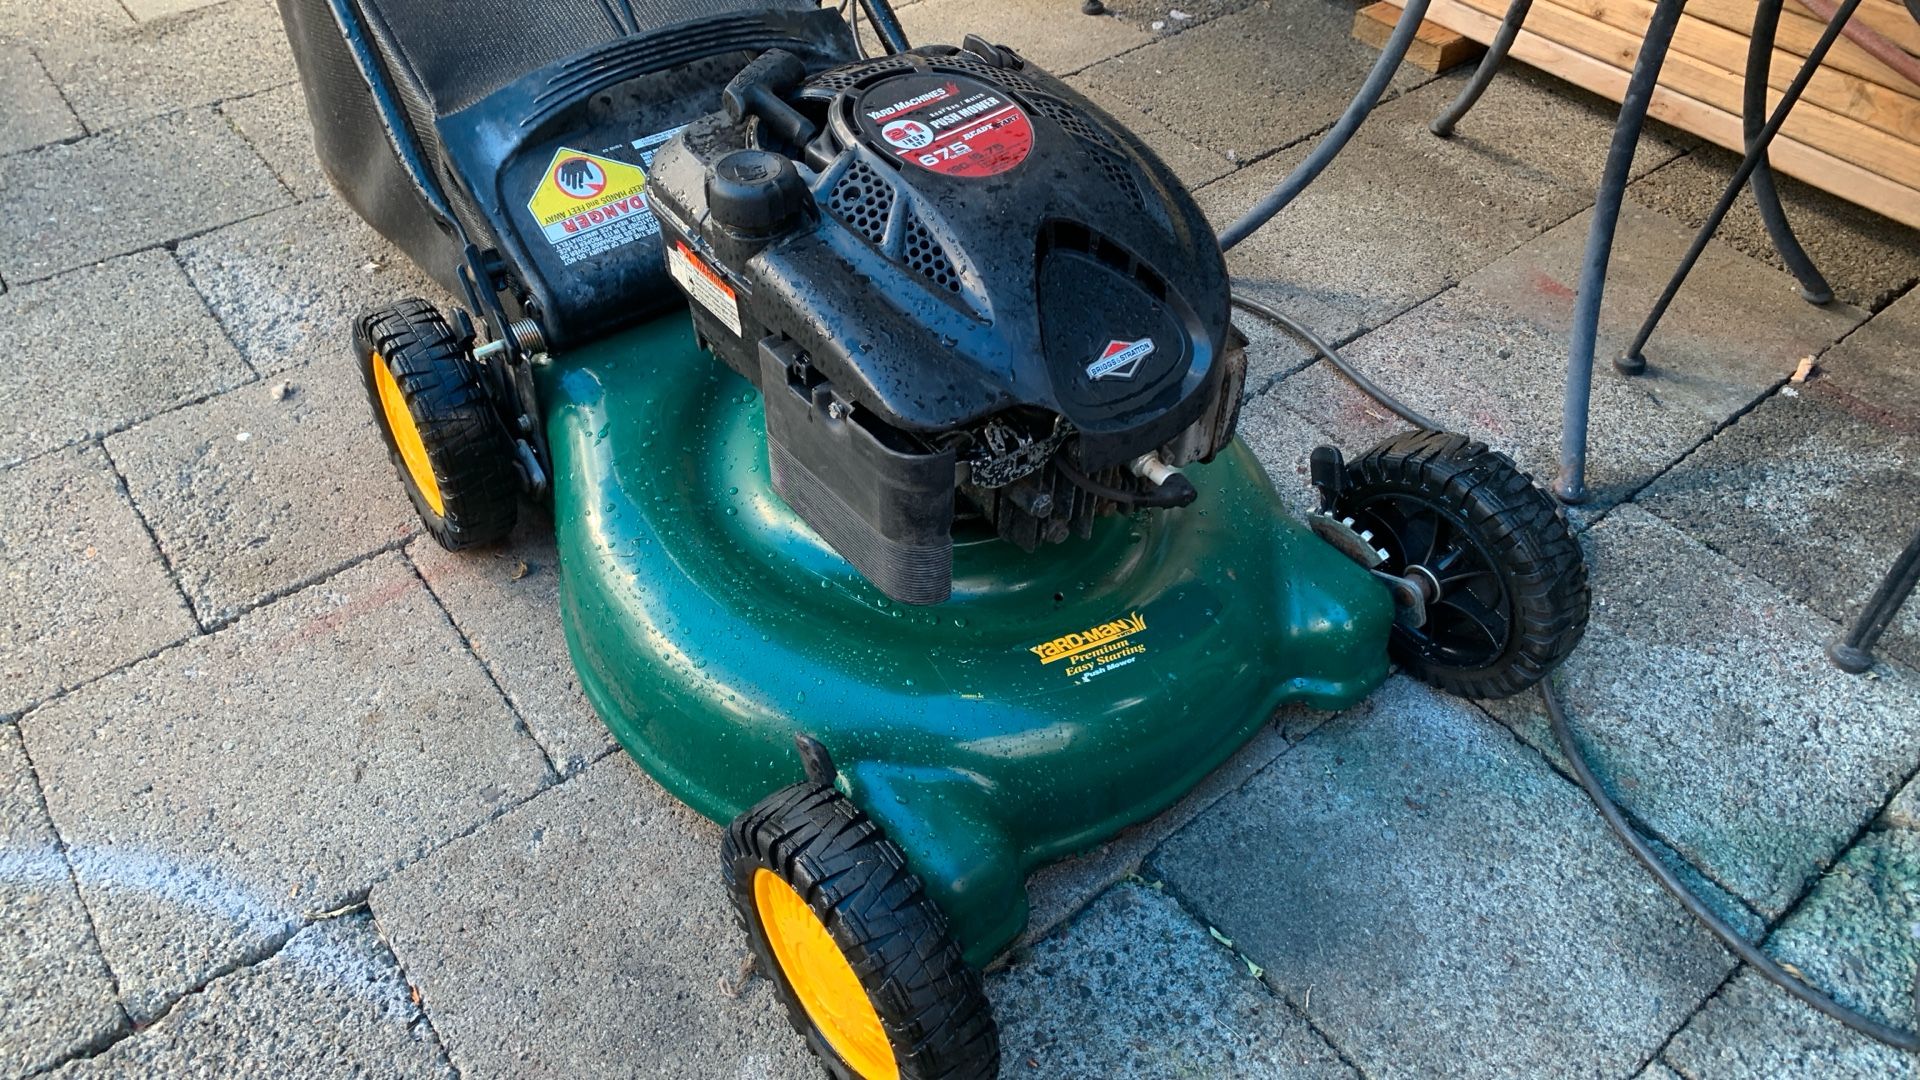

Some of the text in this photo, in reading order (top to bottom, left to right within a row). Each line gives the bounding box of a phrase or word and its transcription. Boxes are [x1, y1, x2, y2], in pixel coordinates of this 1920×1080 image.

[866, 88, 946, 120] YARD MACHINES
[930, 97, 1000, 129] PUSH MOWER
[884, 122, 925, 142] 21
[918, 141, 972, 167] 675
[586, 200, 600, 208] and
[601, 192, 626, 204] HANDS
[544, 214, 566, 224] AWAY
[562, 195, 644, 234] DANGER
[566, 205, 584, 216] FEET
[1065, 643, 1146, 677] Easy Starting
[1069, 640, 1130, 665] Premium
[1106, 656, 1136, 671] Mower
